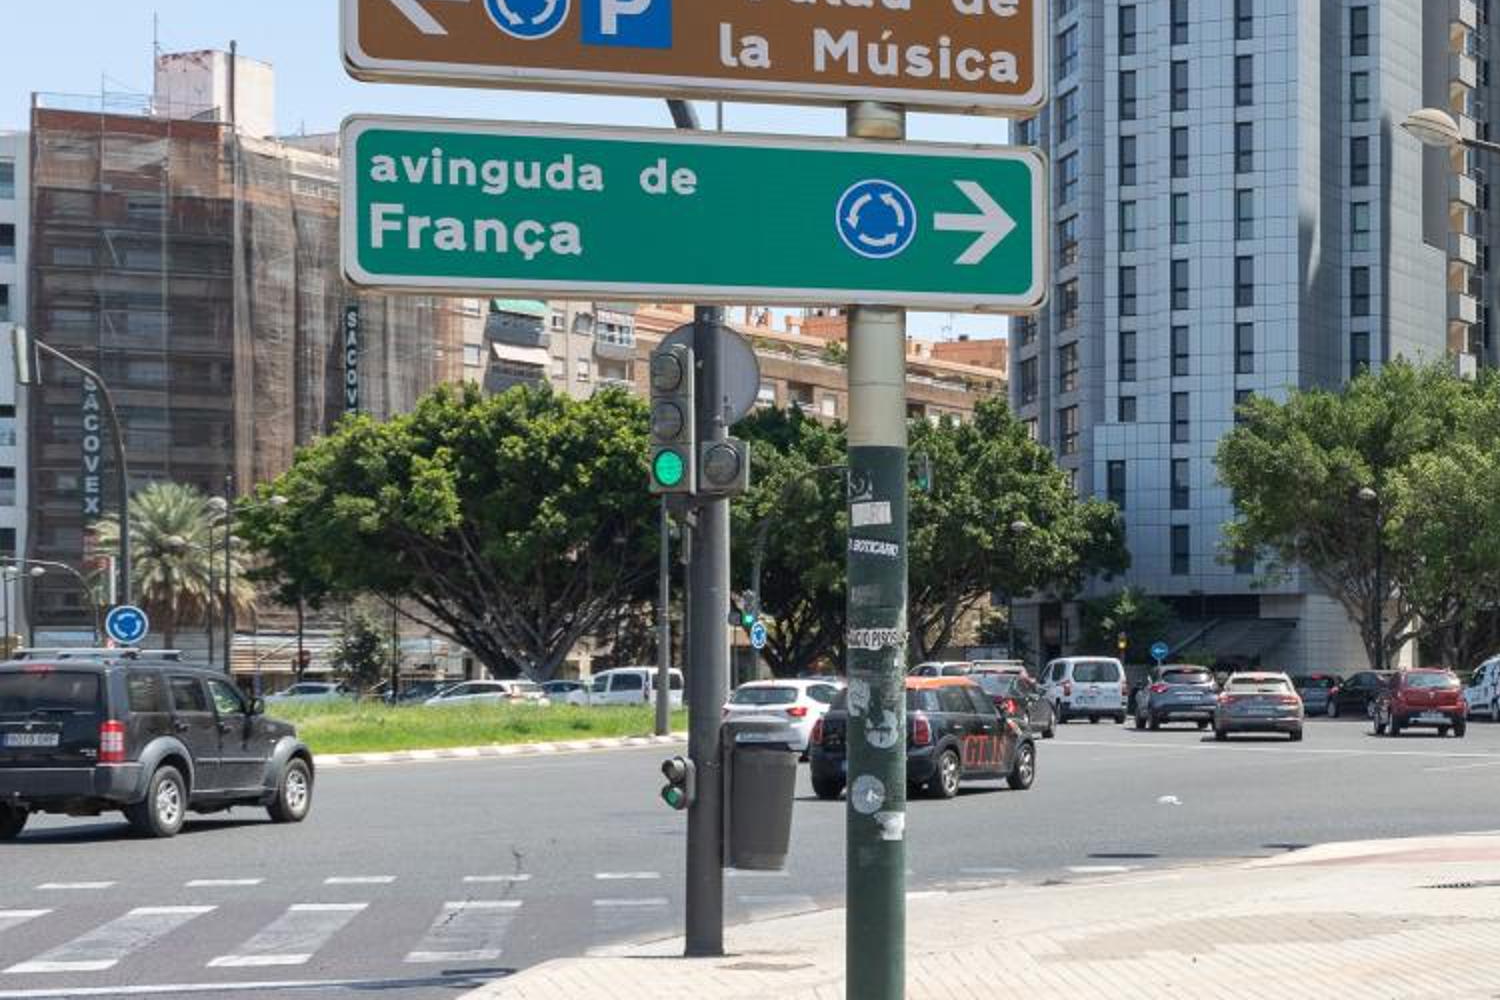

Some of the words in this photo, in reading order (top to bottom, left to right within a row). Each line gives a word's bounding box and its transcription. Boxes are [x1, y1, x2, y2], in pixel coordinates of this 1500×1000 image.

[720, 23, 771, 69] la
[813, 28, 1019, 83] Música
[371, 148, 603, 194] avinguda
[640, 159, 697, 195] de
[371, 203, 581, 259] França
